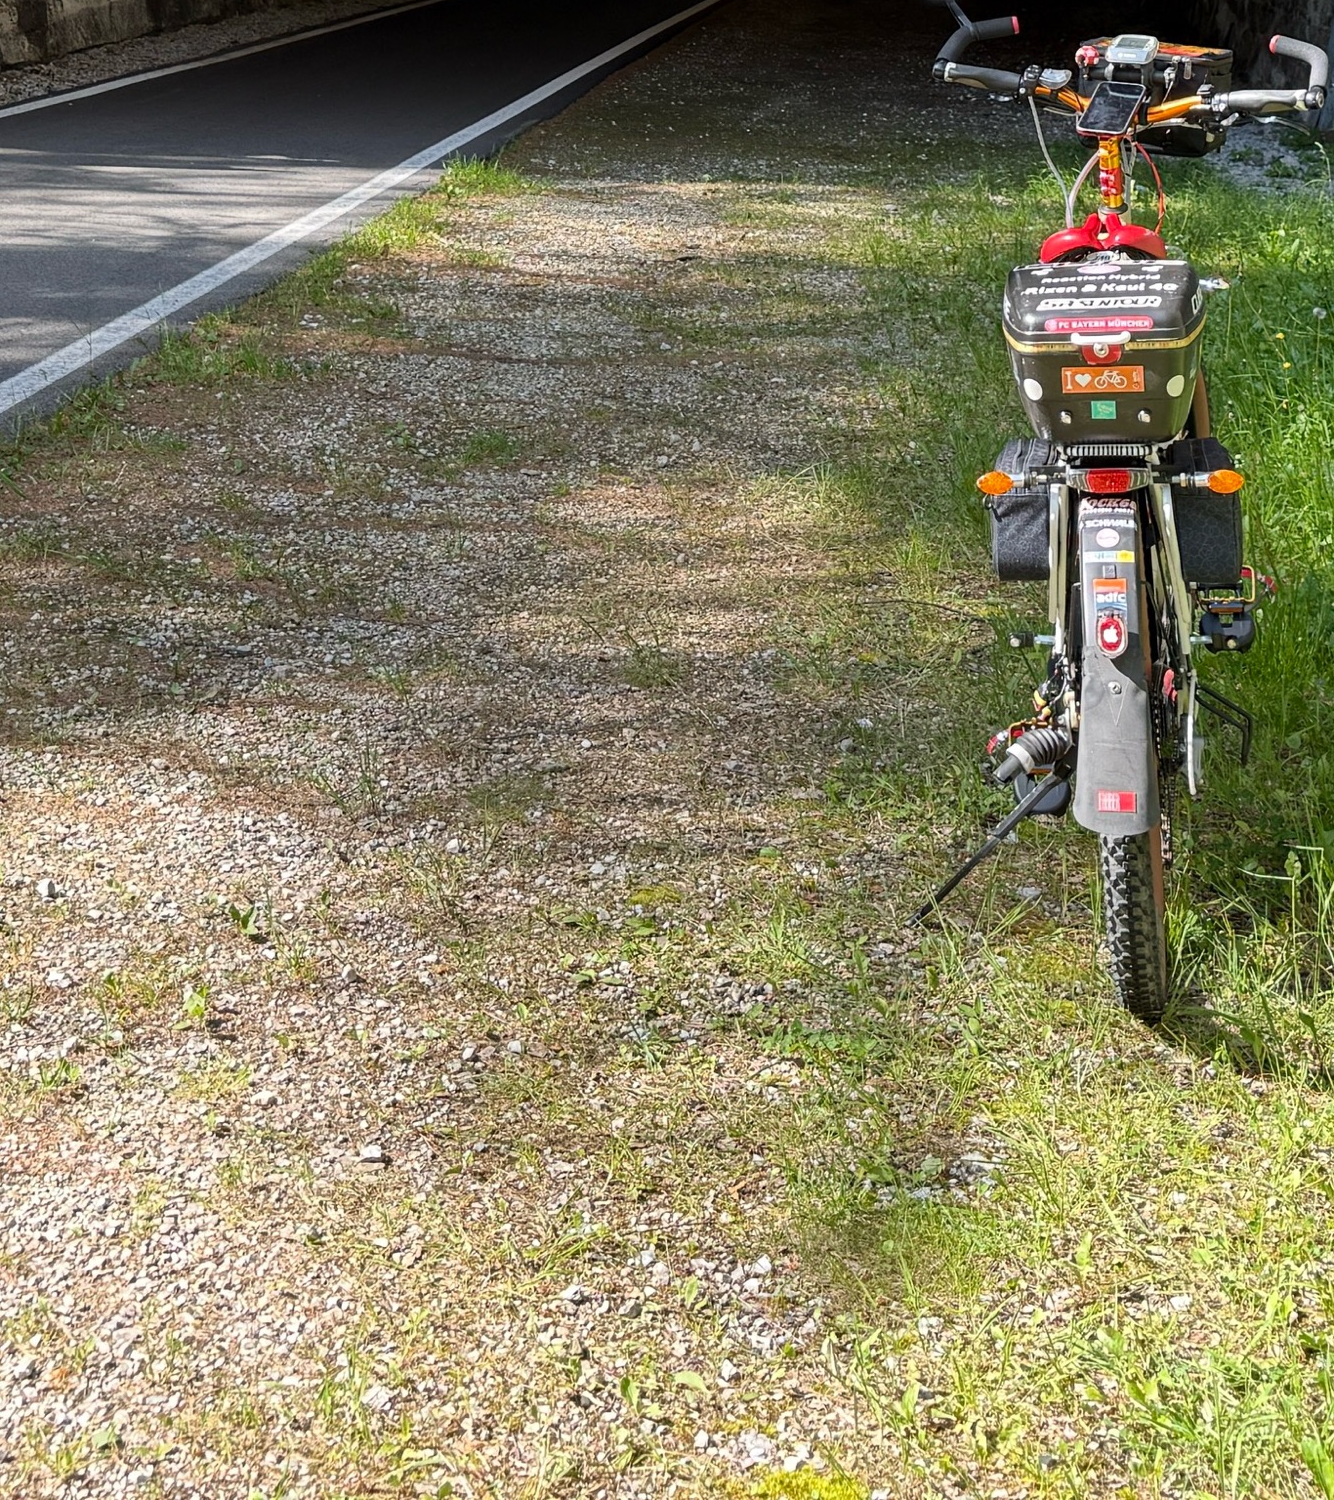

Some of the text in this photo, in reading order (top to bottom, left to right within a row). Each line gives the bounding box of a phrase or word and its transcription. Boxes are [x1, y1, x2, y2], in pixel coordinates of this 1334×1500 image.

[1041, 274, 1161, 284] Reaction Hybrid
[1021, 286, 1078, 296] Rixen
[1081, 284, 1097, 293] &
[1101, 282, 1146, 292] Kaul
[1058, 318, 1150, 330] FC BAYERN MÜNCHEN
[1065, 371, 1073, 390] I
[1096, 590, 1127, 604] adfc
